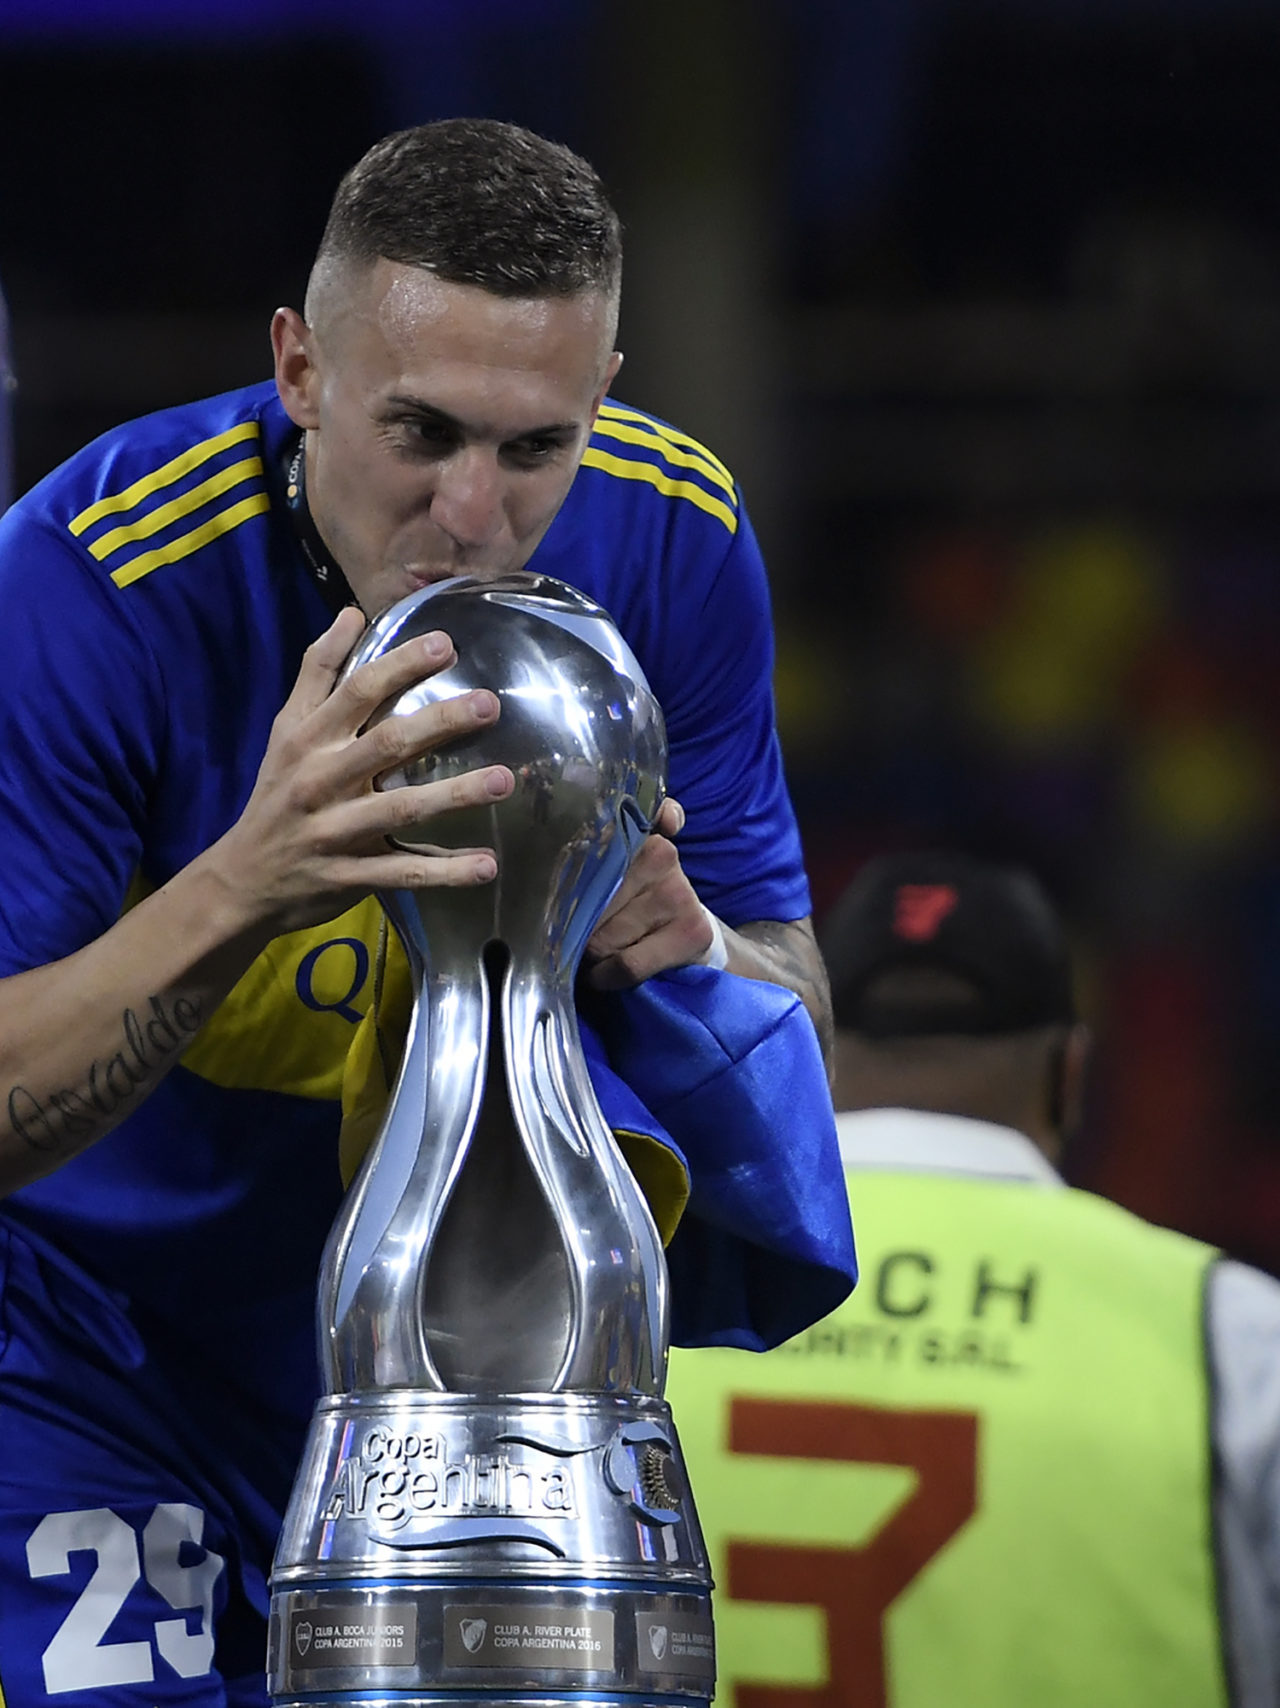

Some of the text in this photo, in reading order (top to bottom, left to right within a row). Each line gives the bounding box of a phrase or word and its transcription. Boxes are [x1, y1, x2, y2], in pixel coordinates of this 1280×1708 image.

[365, 1426, 445, 1465] Copa
[323, 1456, 577, 1527] Argentina
[25, 1503, 224, 1694] 29
[315, 1626, 333, 1637] CLUB
[343, 1625, 365, 1636] BOCA
[366, 1625, 404, 1636] JUORS
[494, 1625, 592, 1638] CLUB A. RIVER PLATE
[314, 1638, 333, 1649] COPA
[380, 1637, 404, 1648] 2015
[494, 1637, 601, 1651] COPA ARGENTINA 2016
